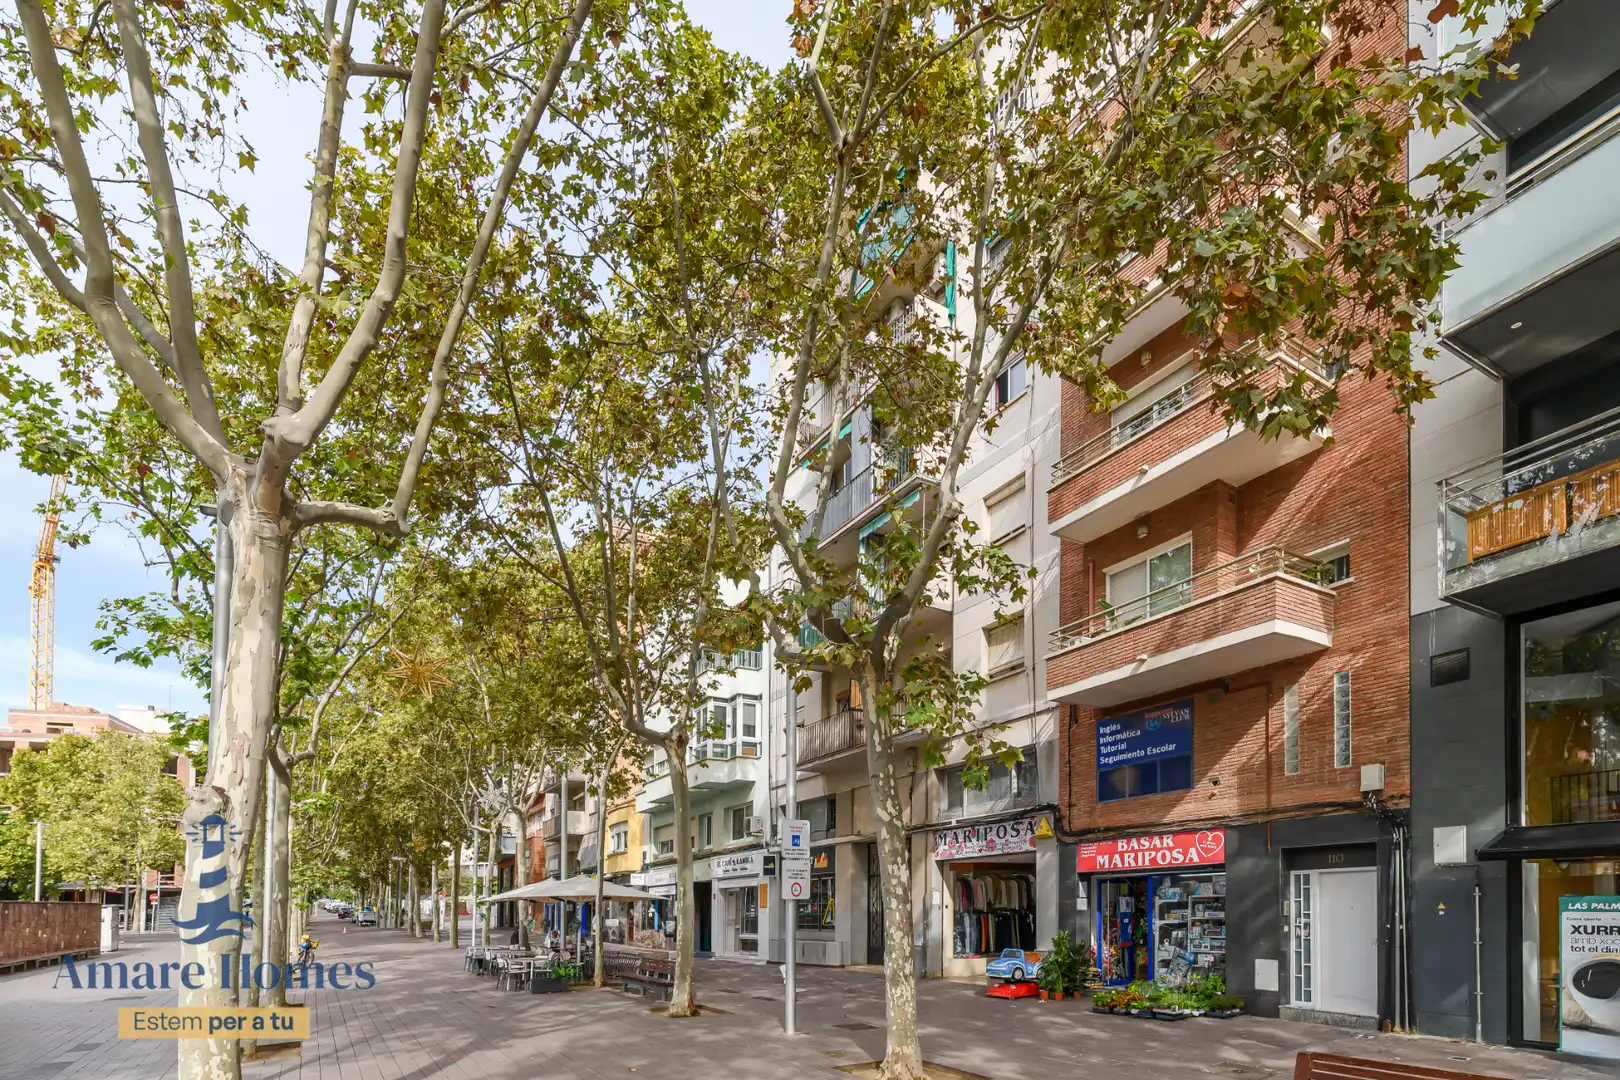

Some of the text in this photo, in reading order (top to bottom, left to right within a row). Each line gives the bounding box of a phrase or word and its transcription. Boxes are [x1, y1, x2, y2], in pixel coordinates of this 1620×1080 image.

[1100, 724, 1121, 734] Inglés
[1100, 729, 1141, 744] Informática
[1100, 742, 1127, 754] Tutorial
[1100, 743, 1176, 765] Seguimiento Escolar
[937, 820, 1036, 847] MARIPOSA
[1117, 833, 1175, 852] BASAR
[1096, 847, 1200, 869] MARIPOSA
[1568, 902, 1588, 910] LAS
[1570, 924, 1620, 936] XURR
[1570, 937, 1597, 945] amb
[1570, 945, 1586, 953] tot
[1588, 945, 1598, 953] el
